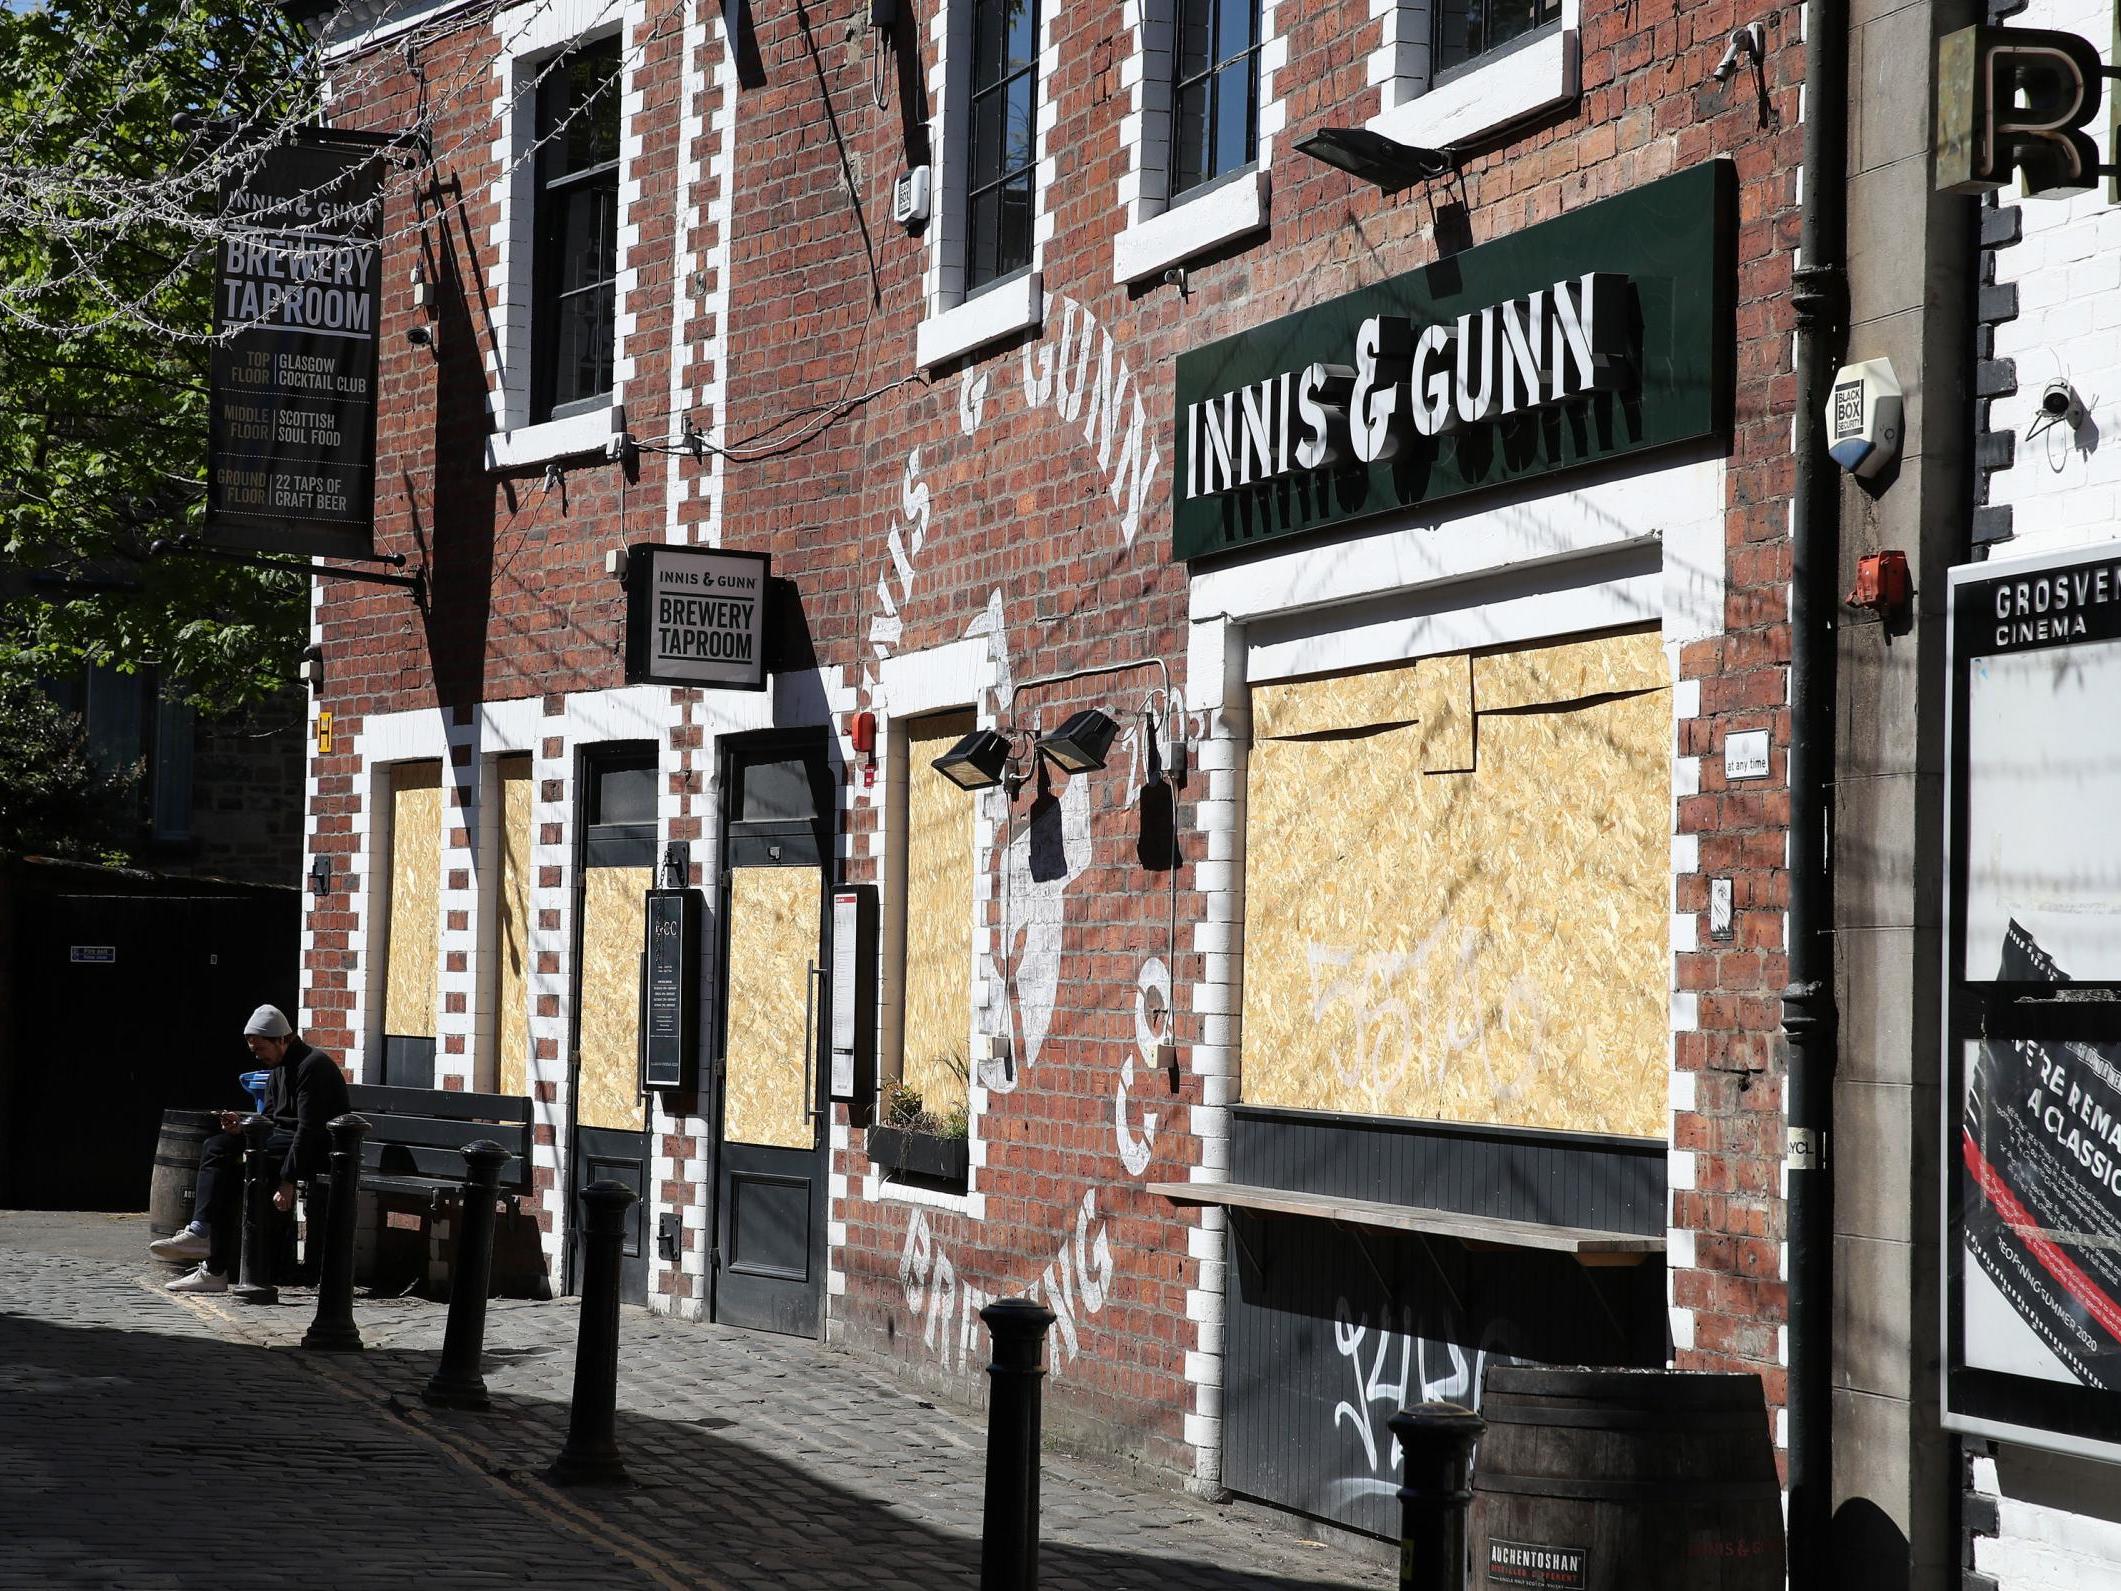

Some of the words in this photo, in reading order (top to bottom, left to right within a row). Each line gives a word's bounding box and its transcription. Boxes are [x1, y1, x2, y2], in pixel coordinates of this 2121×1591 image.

[295, 196, 312, 217] &
[226, 236, 374, 287] BREWERY
[223, 279, 371, 331] TAPROOM
[247, 351, 270, 368] TOP
[279, 353, 336, 373] GLASGOW
[231, 366, 270, 385] FLOOR
[279, 370, 334, 390] COCKTAIL
[337, 376, 367, 393] CLUB
[1186, 362, 1328, 500] INNIS
[1349, 314, 1397, 463] &
[1411, 271, 1596, 437] GUNN
[1838, 388, 1860, 404] BLACK
[224, 404, 270, 423] MIDDLE
[279, 409, 335, 430] SCOTTISH
[1838, 401, 1860, 421] BOX
[230, 421, 269, 440] FLOOR
[1838, 418, 1860, 431] SECURITY
[278, 426, 307, 444] SOUL
[311, 429, 341, 447] FOOD
[217, 468, 267, 488] GROUND
[275, 474, 291, 490] 22
[294, 475, 324, 493] TAPS
[327, 478, 342, 494] OF
[227, 486, 265, 505] FLOOR
[275, 490, 313, 509] CRAFT
[317, 494, 347, 511] BEER
[659, 570, 699, 585] INNIS
[702, 571, 715, 587] &
[717, 576, 756, 589] GUNN
[659, 598, 755, 630] BREWERY
[1995, 614, 2087, 646] CINEMA
[658, 627, 753, 659] TAPROOM
[1728, 760, 1735, 772] at
[1736, 761, 1748, 773] any
[1750, 757, 1767, 770] time
[2027, 1088, 2043, 1118] A
[2044, 1106, 2121, 1197] CLASSIC
[2077, 1325, 2098, 1353] 2020
[1491, 1545, 1578, 1571] AUCHENTOSHAN
